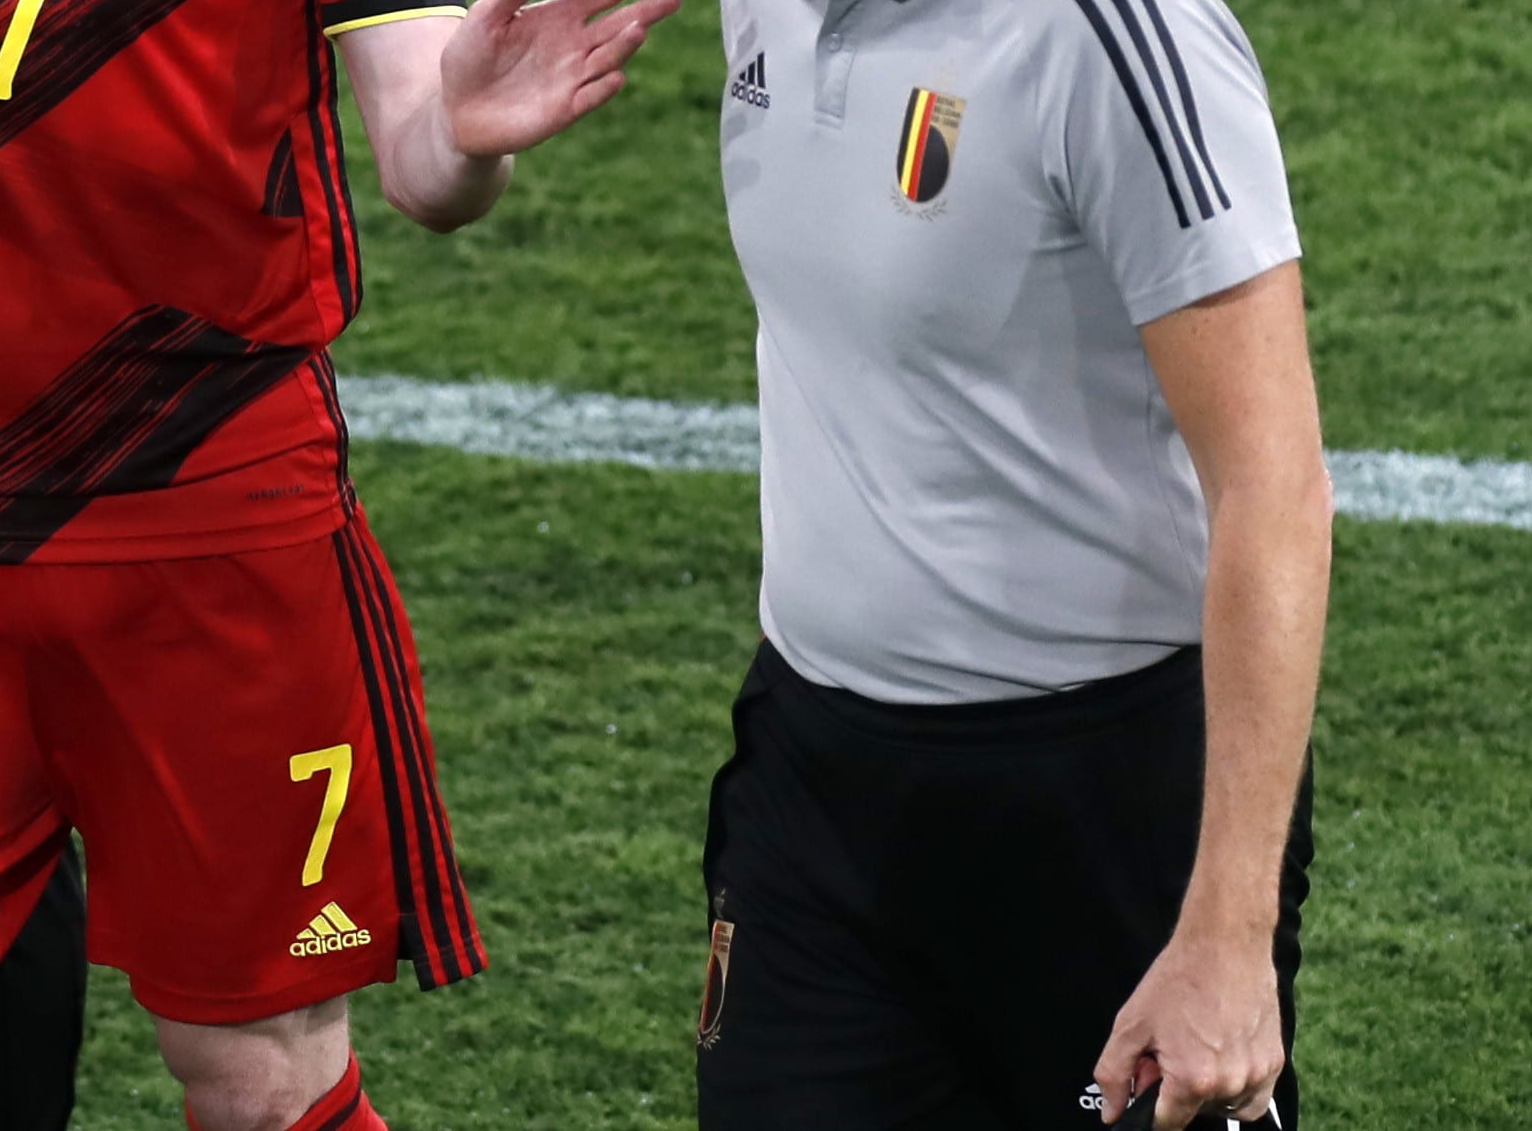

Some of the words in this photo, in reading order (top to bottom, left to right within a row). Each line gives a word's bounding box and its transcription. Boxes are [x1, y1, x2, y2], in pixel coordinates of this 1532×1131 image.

[731, 81, 770, 110] adidas
[289, 743, 352, 887] 7
[289, 928, 371, 957] adidas
